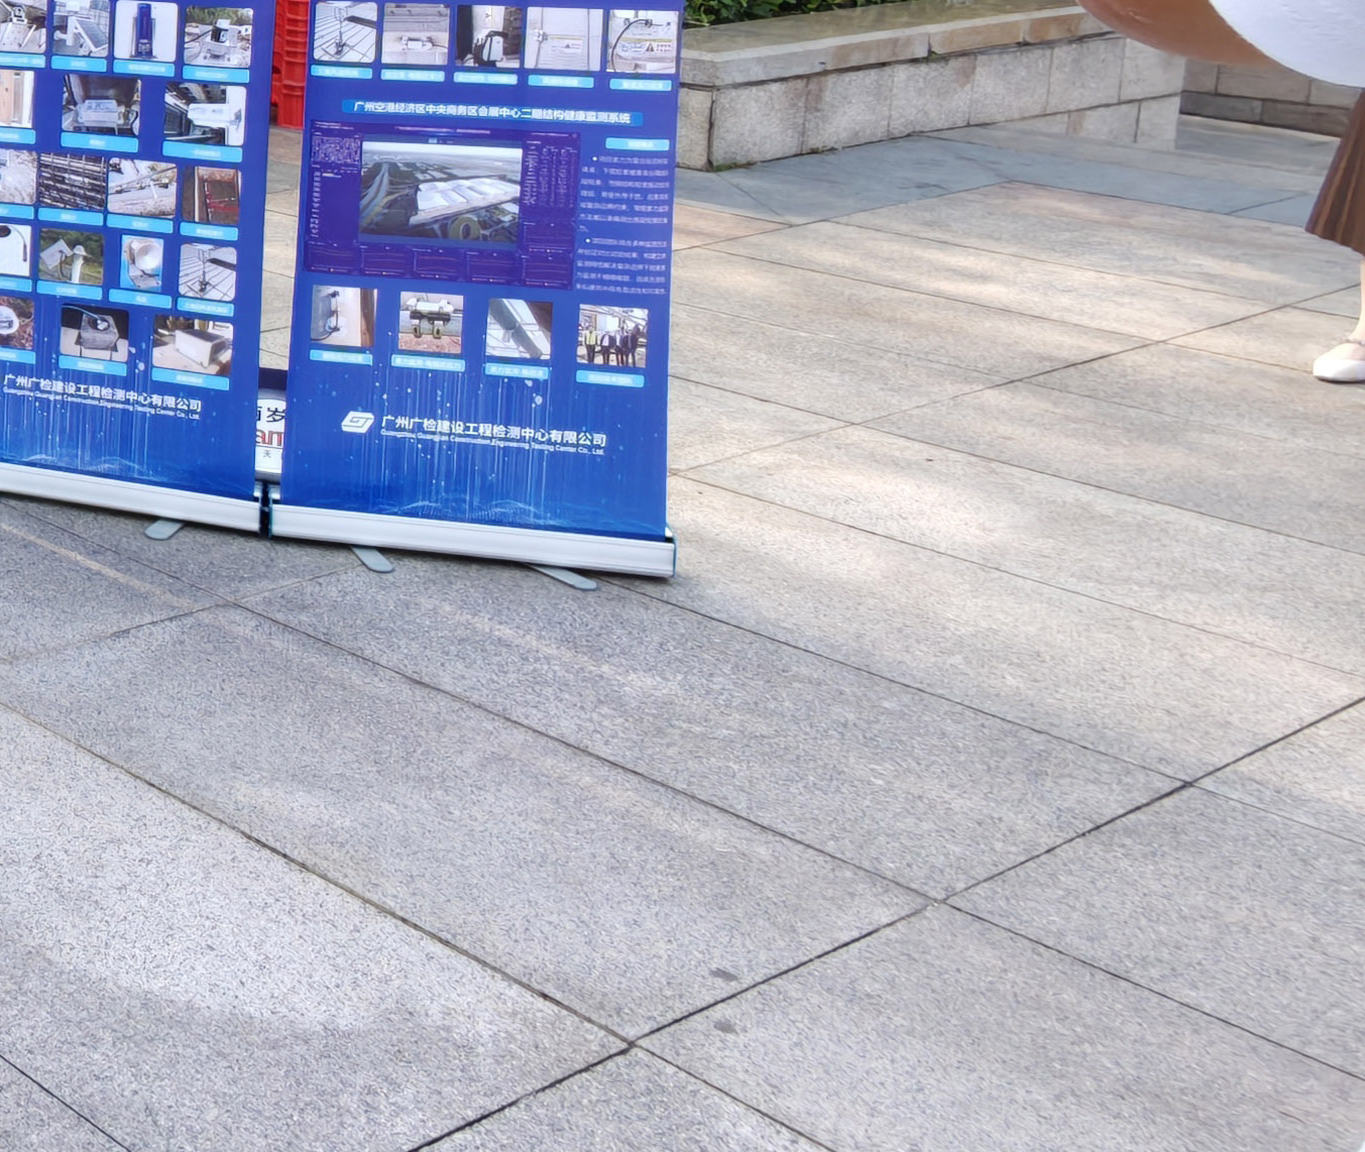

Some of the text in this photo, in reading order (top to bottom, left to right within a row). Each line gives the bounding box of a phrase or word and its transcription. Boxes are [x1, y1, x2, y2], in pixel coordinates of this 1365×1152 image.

[3, 373, 202, 412] 广州广检建设工程检测中心有限公司
[381, 415, 607, 447] 广州广检建设工程检测中心有限公司
